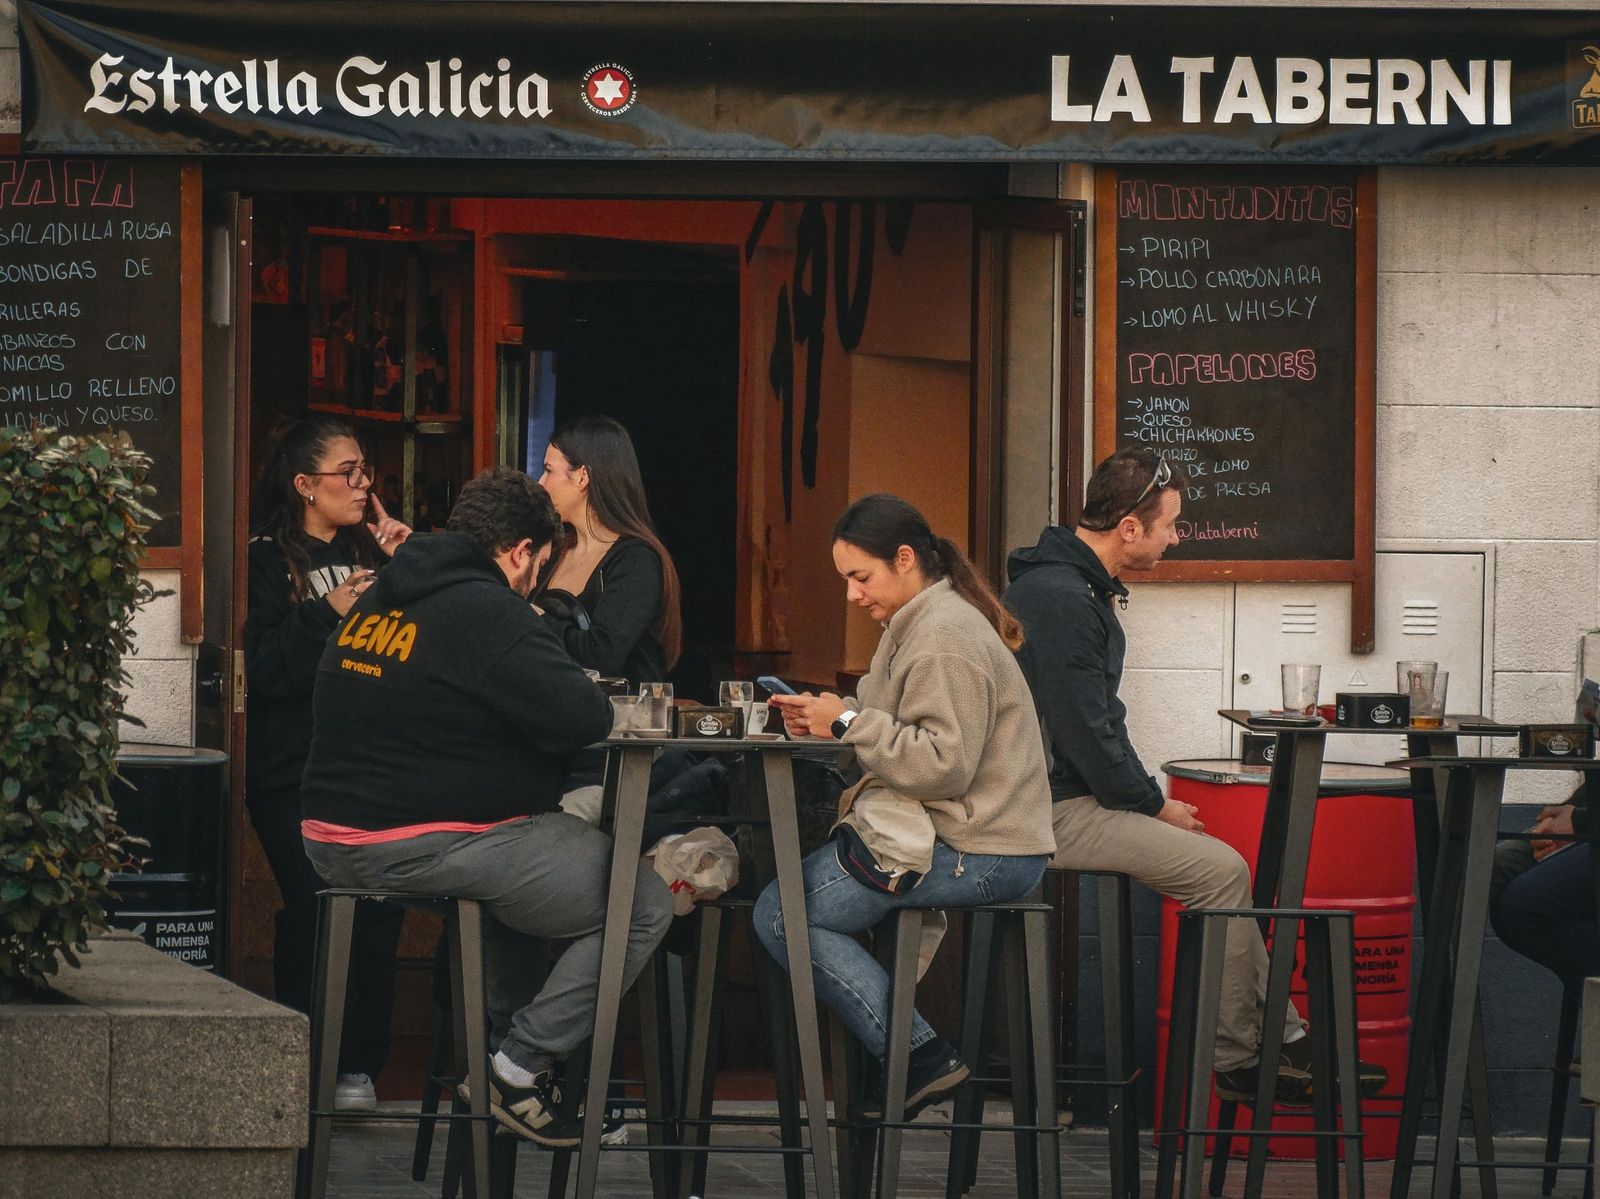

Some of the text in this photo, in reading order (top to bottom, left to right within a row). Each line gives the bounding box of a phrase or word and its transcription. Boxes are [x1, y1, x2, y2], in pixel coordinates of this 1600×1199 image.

[583, 62, 634, 81] ESTRELLA GALICIA
[84, 55, 553, 119] Estrella Galicia
[1051, 55, 1512, 126] LA TABERNI
[1576, 104, 1600, 124] TA
[1119, 179, 1353, 229] MONTADITOS
[1141, 237, 1211, 260] PIRIPI
[125, 257, 153, 279] DE
[1138, 264, 1322, 290] POLLO CARBONARA
[1142, 295, 1318, 328] LOMO AL WHISKY
[0, 332, 146, 351] BANZOS CON
[1128, 349, 1317, 386] PAPELONES
[88, 376, 176, 398] RELLENO
[1142, 412, 1192, 427] QUESO
[1187, 459, 1250, 478] DE LOMO
[1187, 486, 1207, 501] DE
[337, 609, 417, 662] LEÑA
[156, 921, 214, 934] PARA UNA
[155, 935, 210, 948] INMENSA
